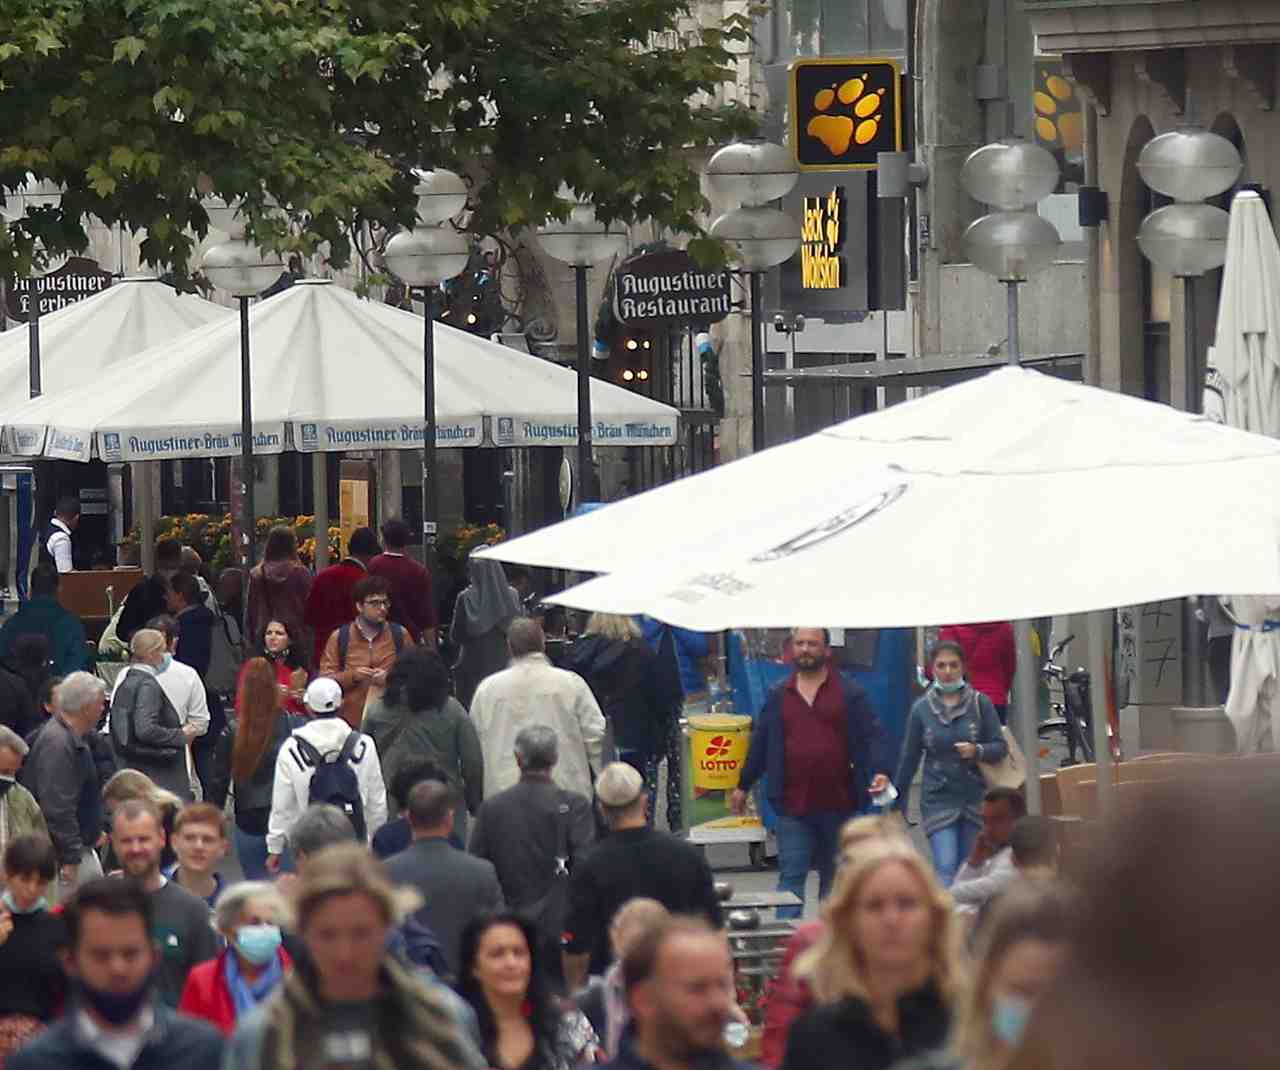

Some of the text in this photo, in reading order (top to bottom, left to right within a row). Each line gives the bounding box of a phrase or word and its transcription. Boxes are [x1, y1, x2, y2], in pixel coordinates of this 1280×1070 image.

[801, 196, 824, 242] Jack
[801, 244, 840, 289] Wolfskin
[622, 272, 727, 296] Augustiner
[621, 294, 729, 318] Restaurant
[701, 759, 738, 771] LOTTO
